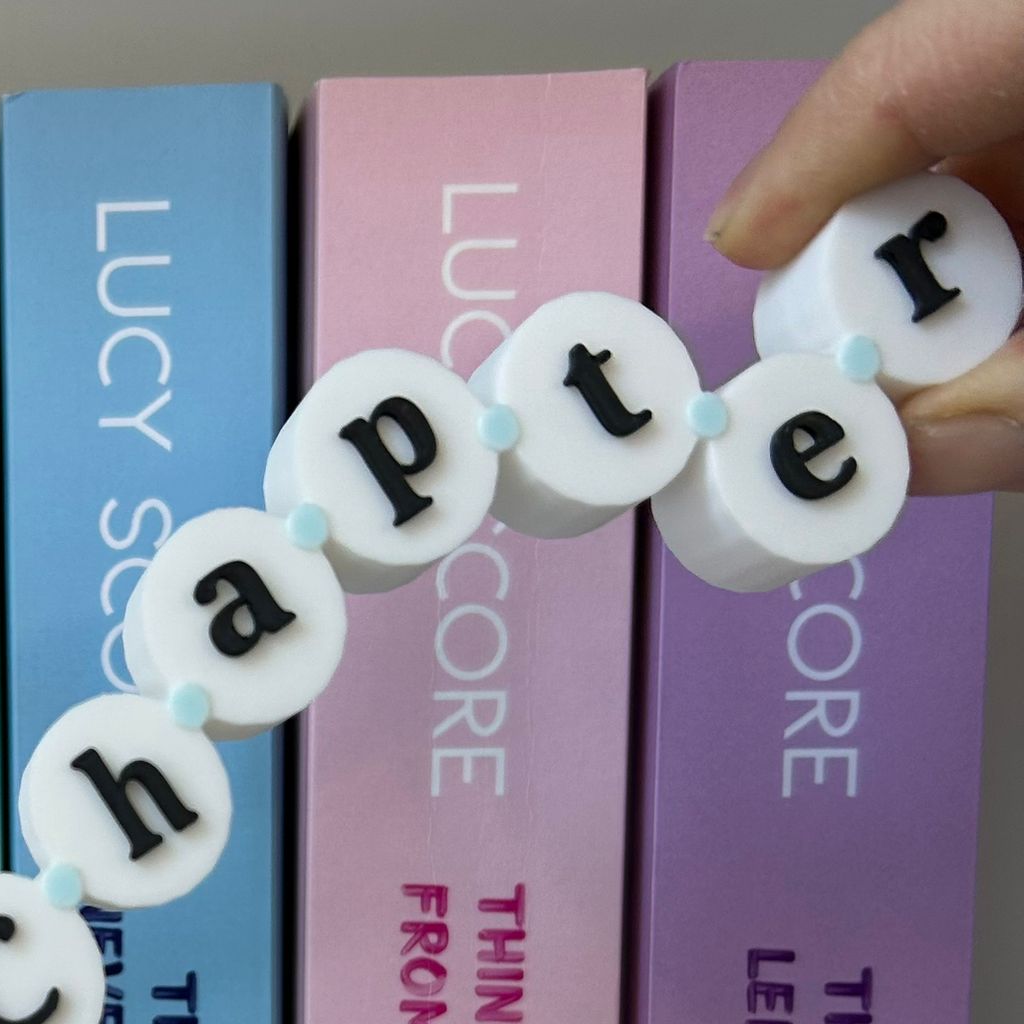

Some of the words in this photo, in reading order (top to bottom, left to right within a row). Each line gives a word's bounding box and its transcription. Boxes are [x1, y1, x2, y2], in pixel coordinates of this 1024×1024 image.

[96, 201, 172, 452] LUCY
[440, 183, 519, 366] LUC
[99, 498, 172, 694] SCO
[430, 520, 512, 797] CORE
